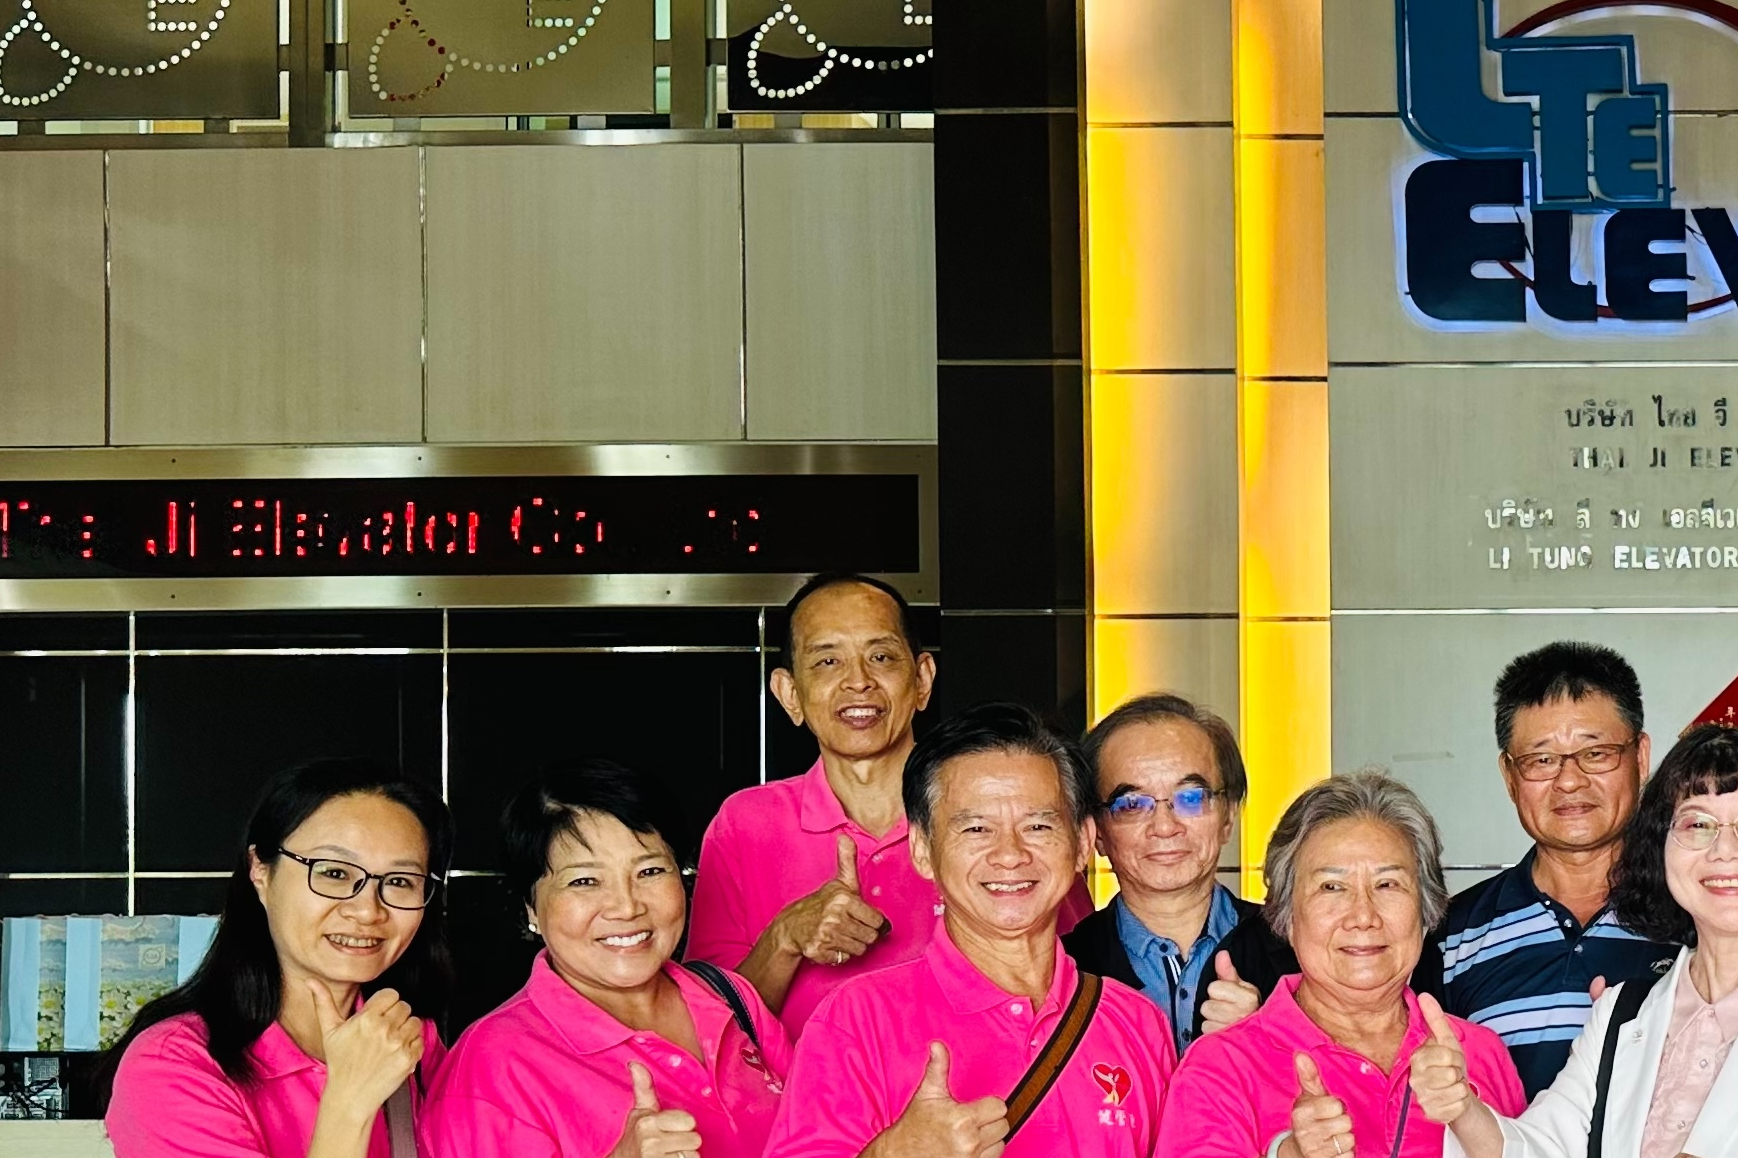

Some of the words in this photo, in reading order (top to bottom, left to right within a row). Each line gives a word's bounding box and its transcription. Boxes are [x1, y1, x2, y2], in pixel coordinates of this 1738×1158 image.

[1651, 394, 1697, 428] ไทย
[1570, 447, 1625, 469] THAI
[1649, 447, 1667, 468] JI
[1488, 547, 1510, 570] LI
[1613, 546, 1738, 570] ELEVATOR
